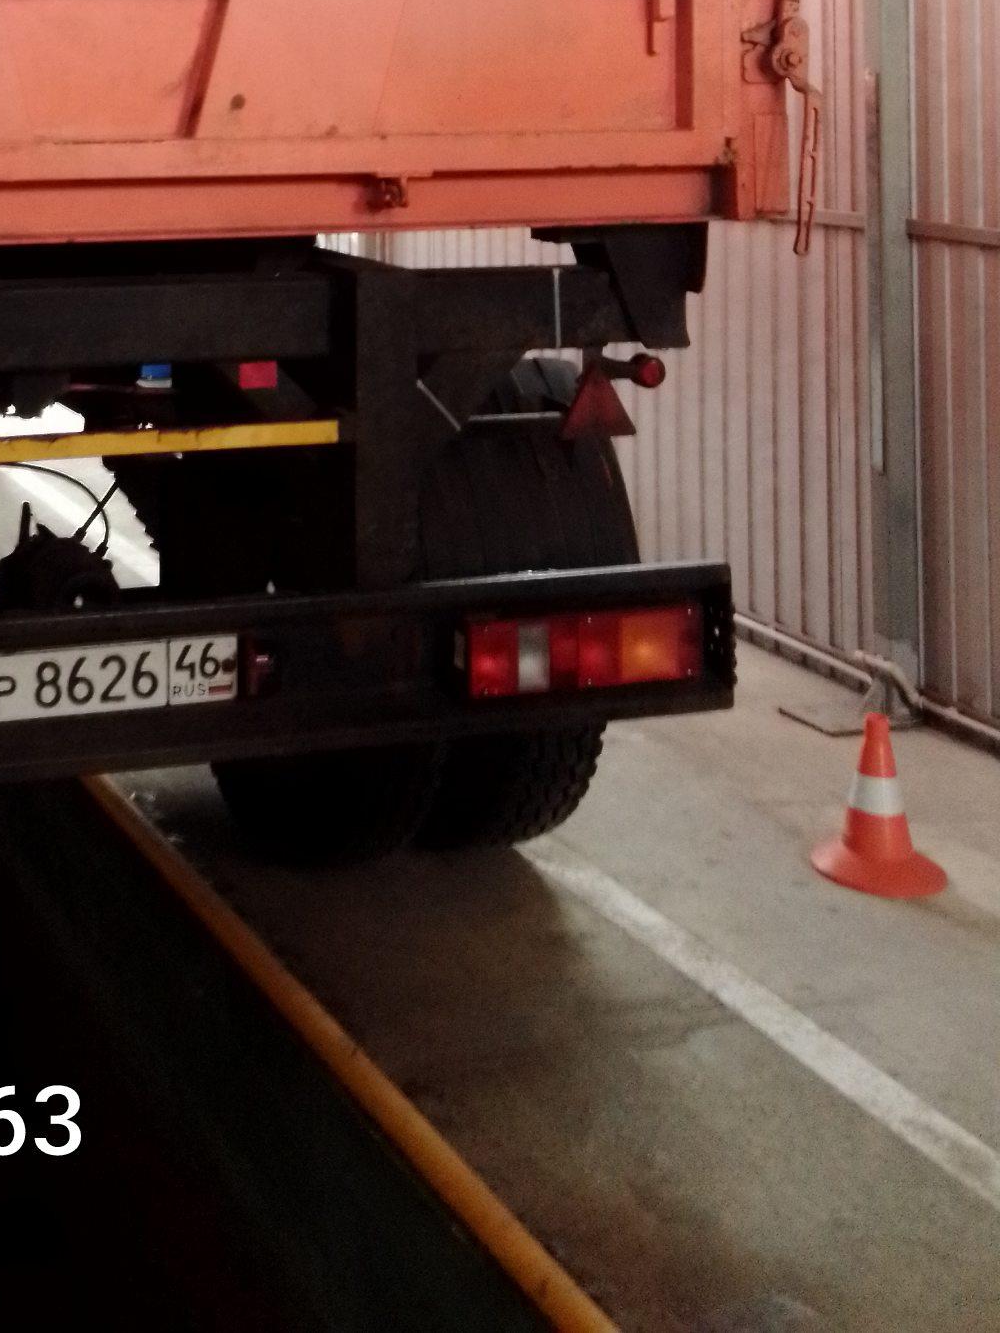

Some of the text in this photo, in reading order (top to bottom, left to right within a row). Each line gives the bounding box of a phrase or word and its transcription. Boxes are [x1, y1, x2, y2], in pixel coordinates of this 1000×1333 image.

[34, 651, 159, 709] 8626
[174, 642, 221, 681] 46
[172, 683, 207, 698] RUS
